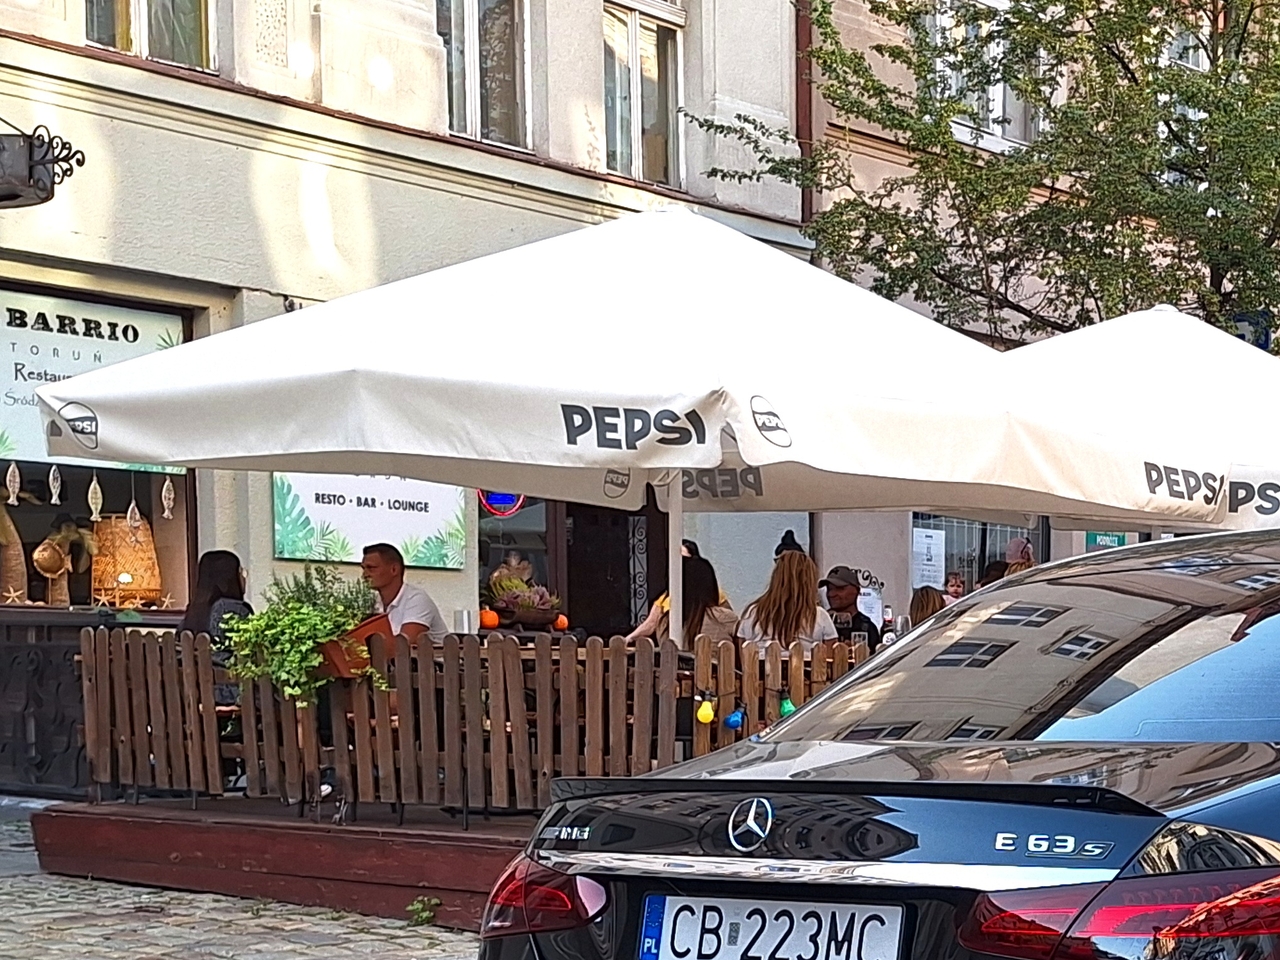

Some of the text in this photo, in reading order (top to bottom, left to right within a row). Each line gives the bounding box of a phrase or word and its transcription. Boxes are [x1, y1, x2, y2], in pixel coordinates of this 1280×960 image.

[6, 307, 140, 344] BARRIO
[10, 342, 103, 363] TORUŃ
[561, 403, 706, 450] PEPSI
[1144, 461, 1225, 505] PEPSI
[314, 492, 430, 513] RESTO BAR LOUNGE
[995, 832, 1018, 851] E
[644, 938, 658, 953] PL
[670, 904, 723, 960] CB
